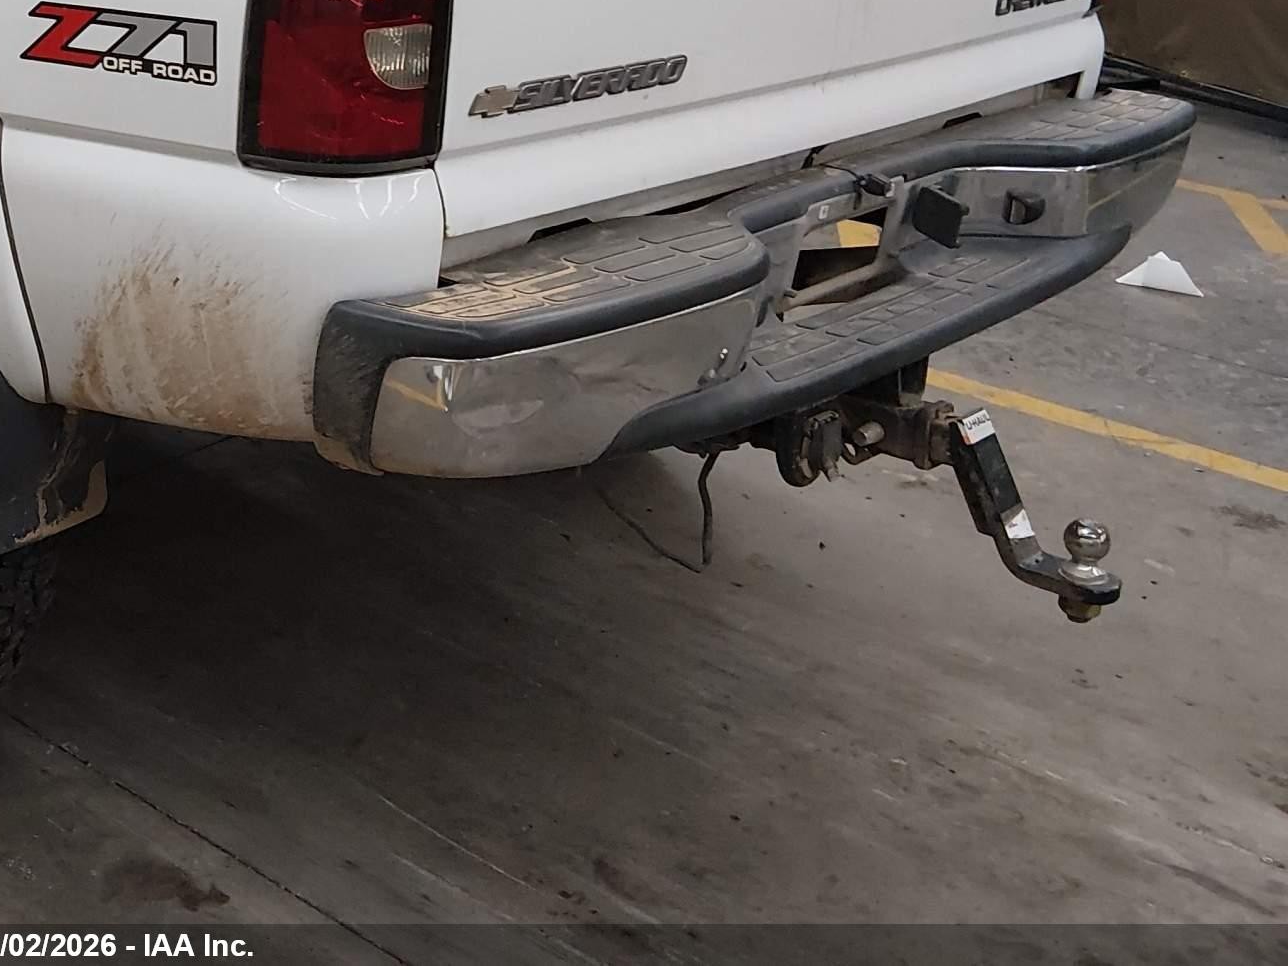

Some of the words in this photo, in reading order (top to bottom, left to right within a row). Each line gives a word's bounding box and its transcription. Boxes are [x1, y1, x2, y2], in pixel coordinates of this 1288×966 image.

[20, 1, 217, 68] Z71
[103, 55, 143, 74] OFF
[151, 62, 217, 85] ROAD
[506, 54, 688, 114] SILVERADO
